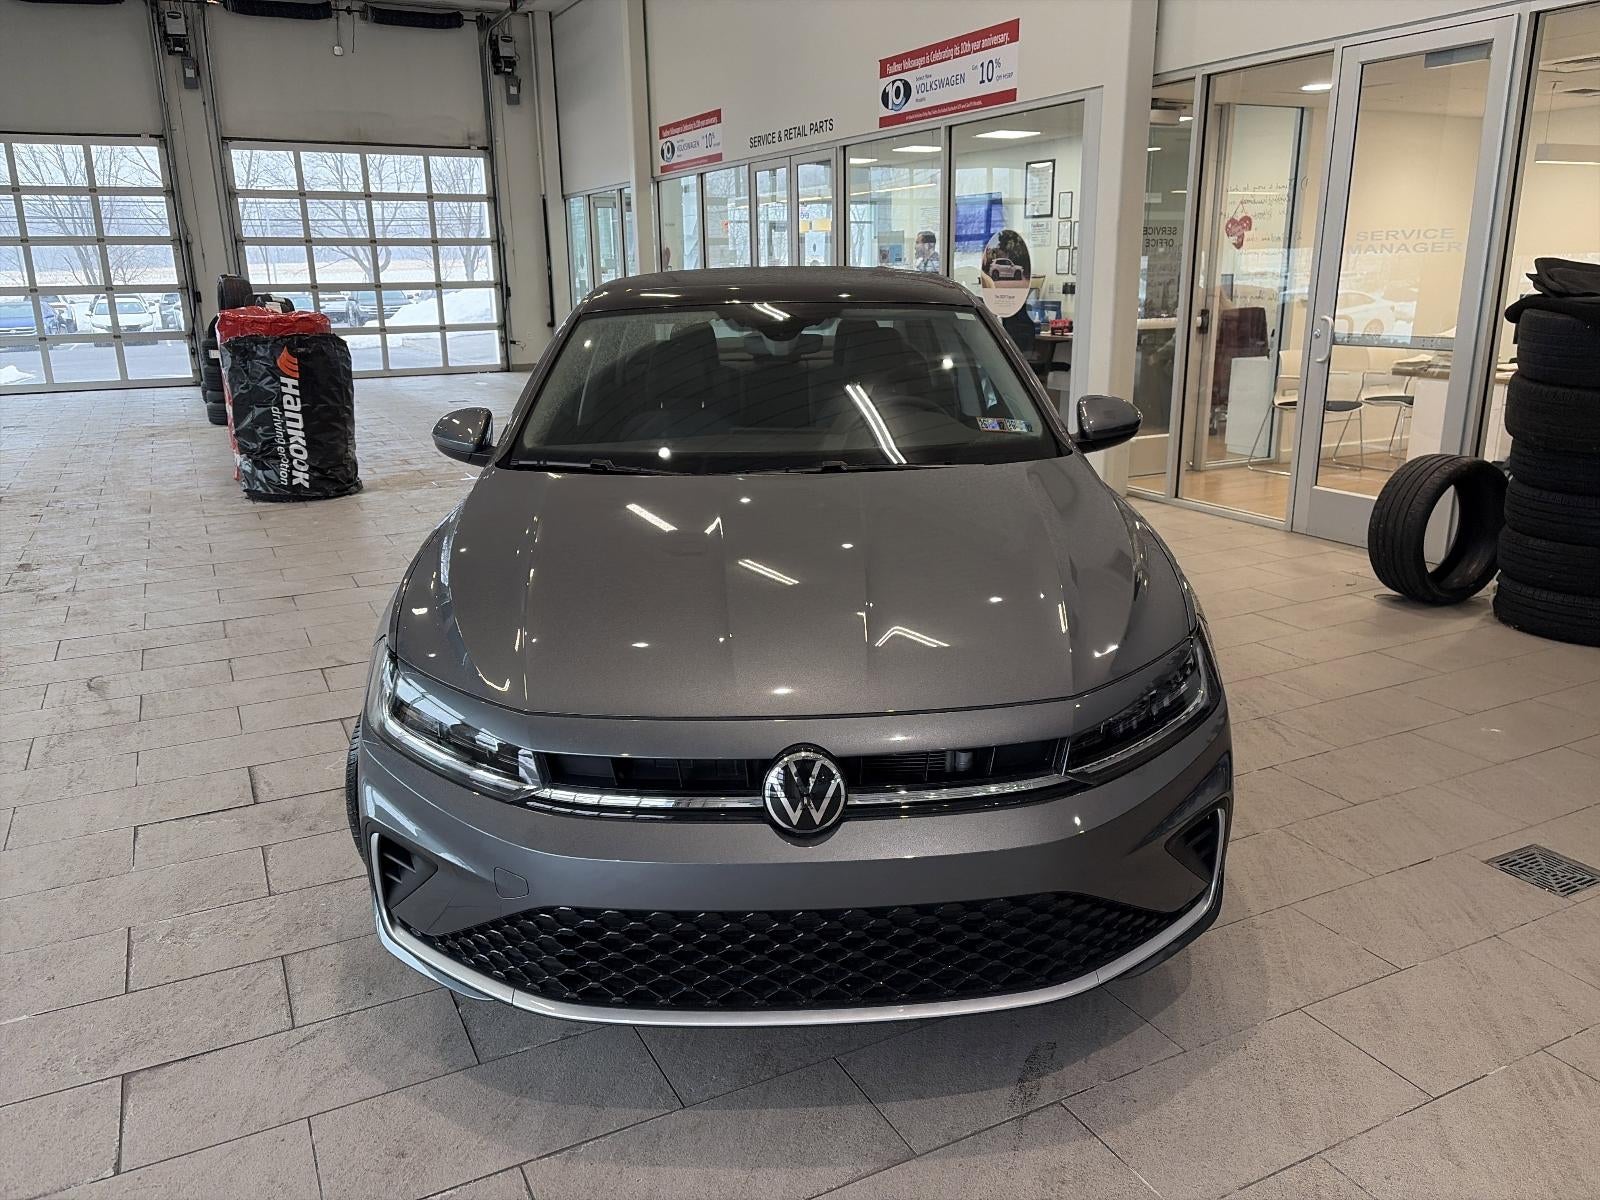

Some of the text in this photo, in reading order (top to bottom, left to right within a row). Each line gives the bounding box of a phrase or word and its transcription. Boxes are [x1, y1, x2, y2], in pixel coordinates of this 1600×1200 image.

[886, 61, 903, 75] Faulkner
[902, 56, 926, 70] Volkswagen
[925, 52, 930, 64] is
[930, 45, 954, 64] Celebrating
[971, 39, 982, 55] year
[981, 32, 1010, 49] anniversary.
[915, 72, 966, 95] VOLKSWAGEN
[749, 118, 834, 149] SERVICE & RETAIL PARTS
[1345, 241, 1464, 256] MANAGER
[1355, 227, 1457, 241] SERVICE
[271, 406, 286, 445] driving
[280, 376, 309, 488] Hankook
[766, 756, 843, 829] VW
